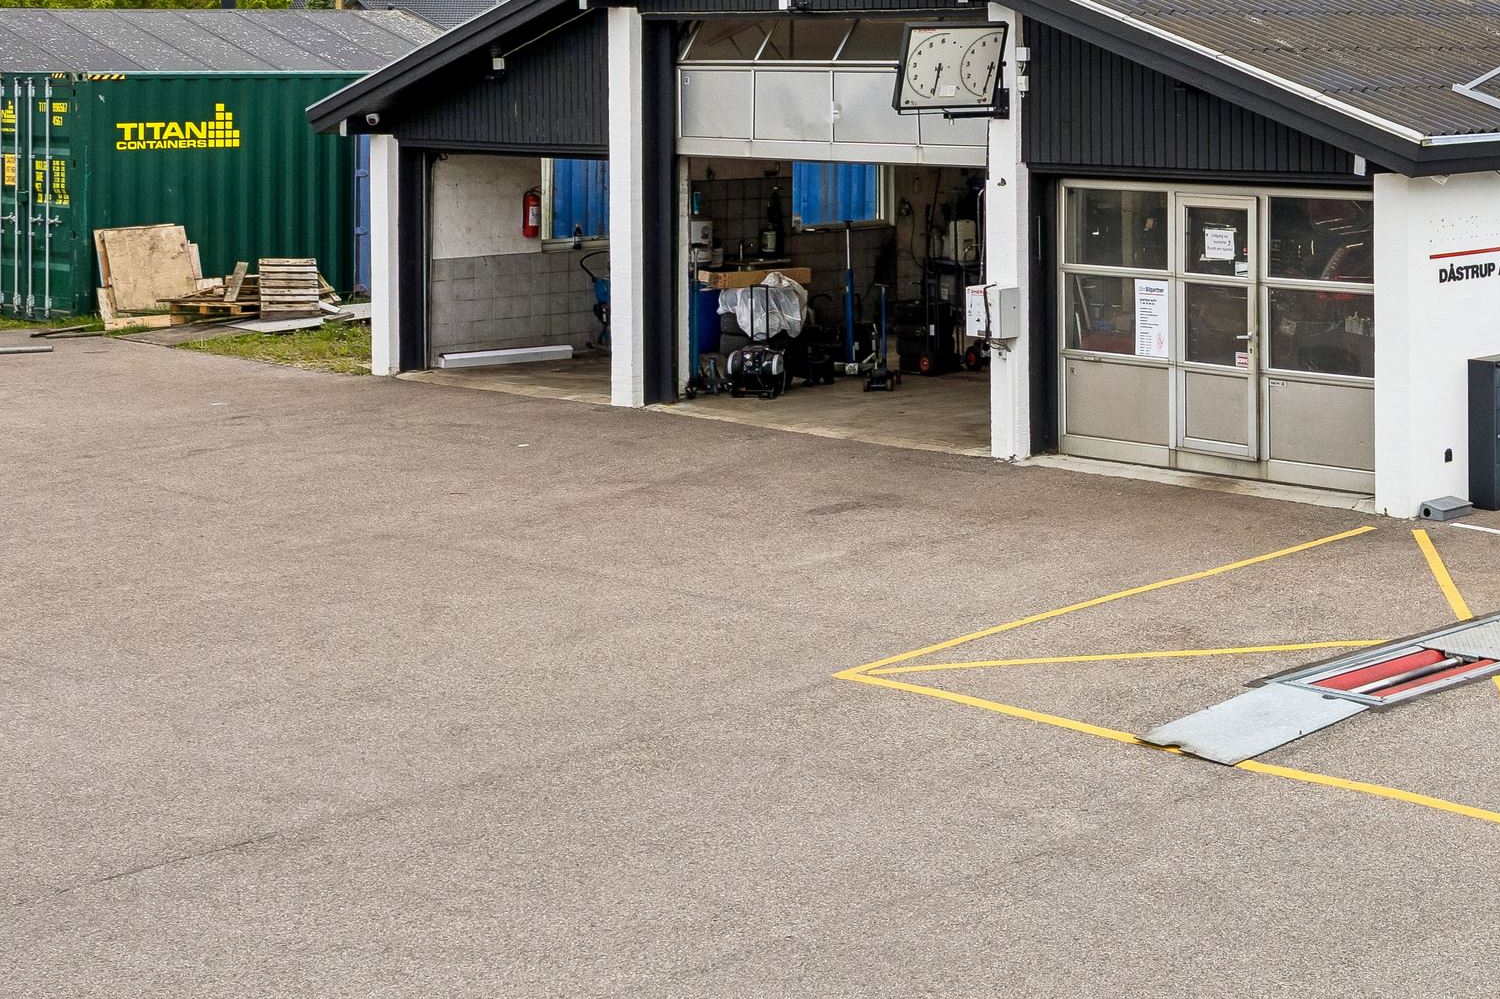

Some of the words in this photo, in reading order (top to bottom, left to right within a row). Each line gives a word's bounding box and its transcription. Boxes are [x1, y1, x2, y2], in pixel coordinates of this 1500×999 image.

[116, 122, 206, 140] TITAN
[116, 140, 207, 150] CONTAINERS
[1439, 263, 1496, 284] DÅSTRUP
